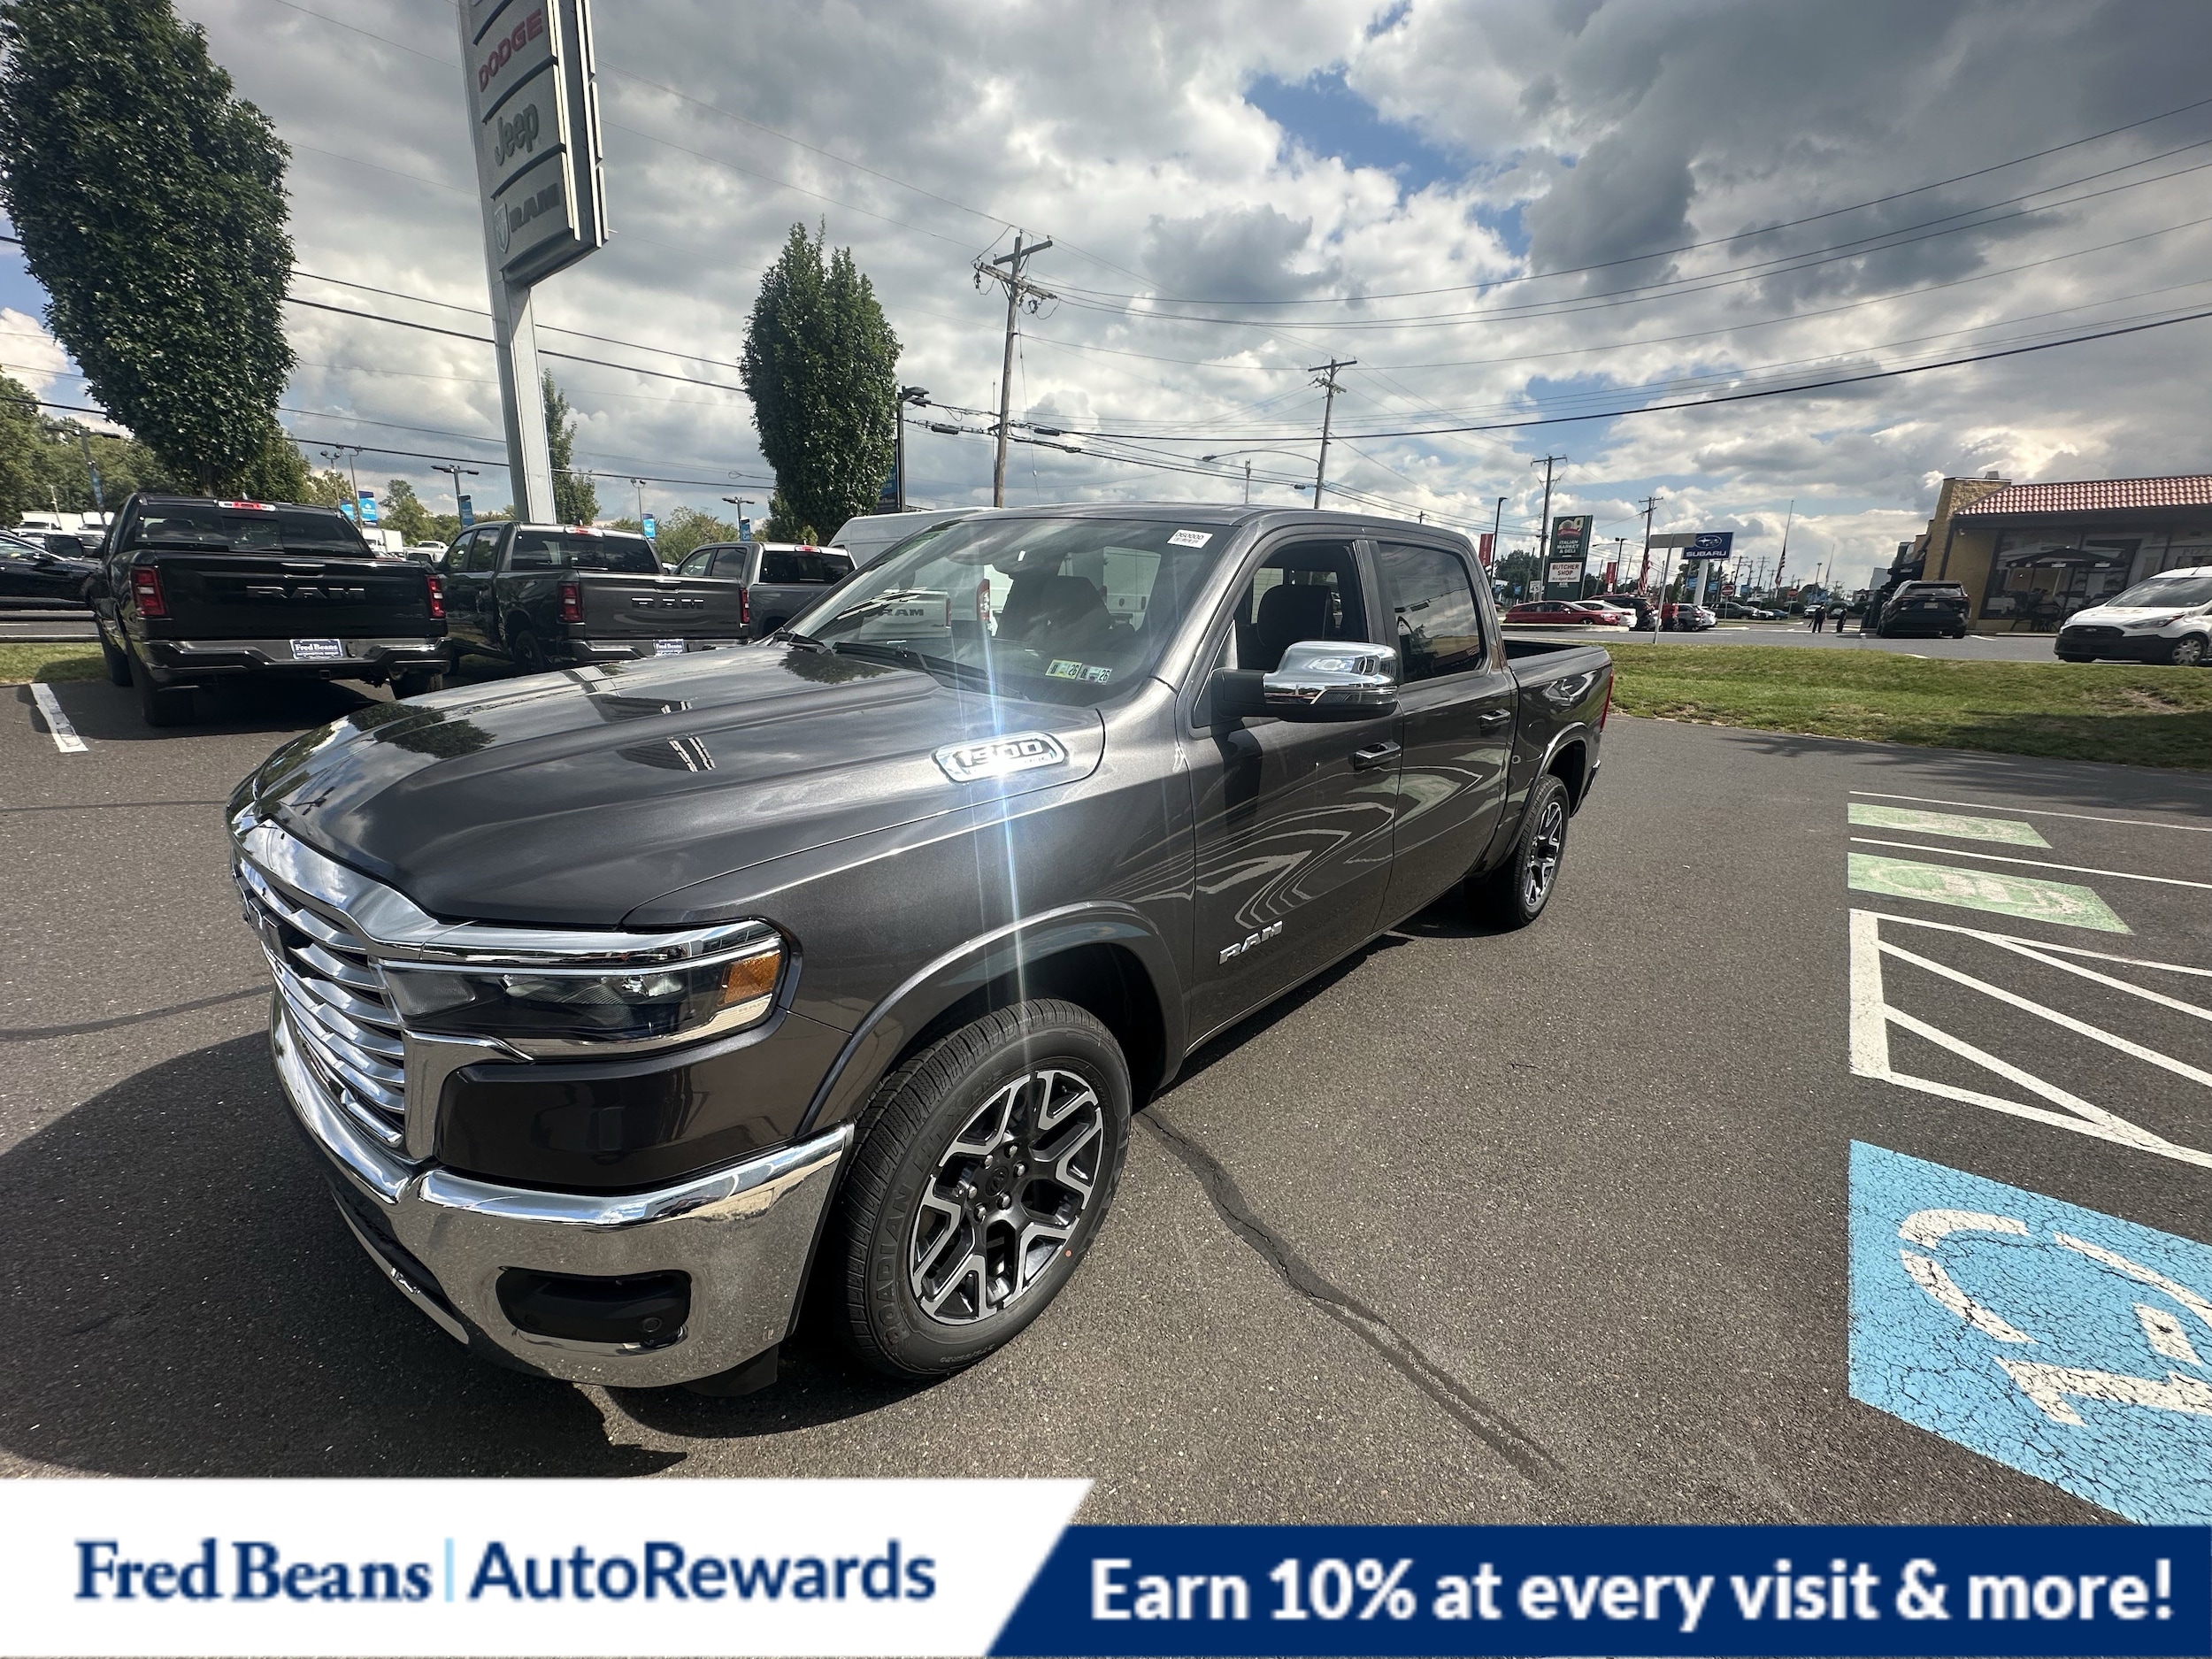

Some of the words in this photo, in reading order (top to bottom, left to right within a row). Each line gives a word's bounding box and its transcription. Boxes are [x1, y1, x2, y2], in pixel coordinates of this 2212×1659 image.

[478, 8, 543, 93] DODGE
[494, 104, 540, 167] Jeep
[509, 182, 561, 234] RAM
[246, 586, 367, 600] RAM
[631, 597, 705, 610] RAM
[877, 608, 925, 618] RAM
[1068, 664, 1079, 677] 26
[1099, 670, 1110, 682] 26
[1218, 920, 1283, 965] RAM
[876, 1183, 915, 1346] ROADIAN
